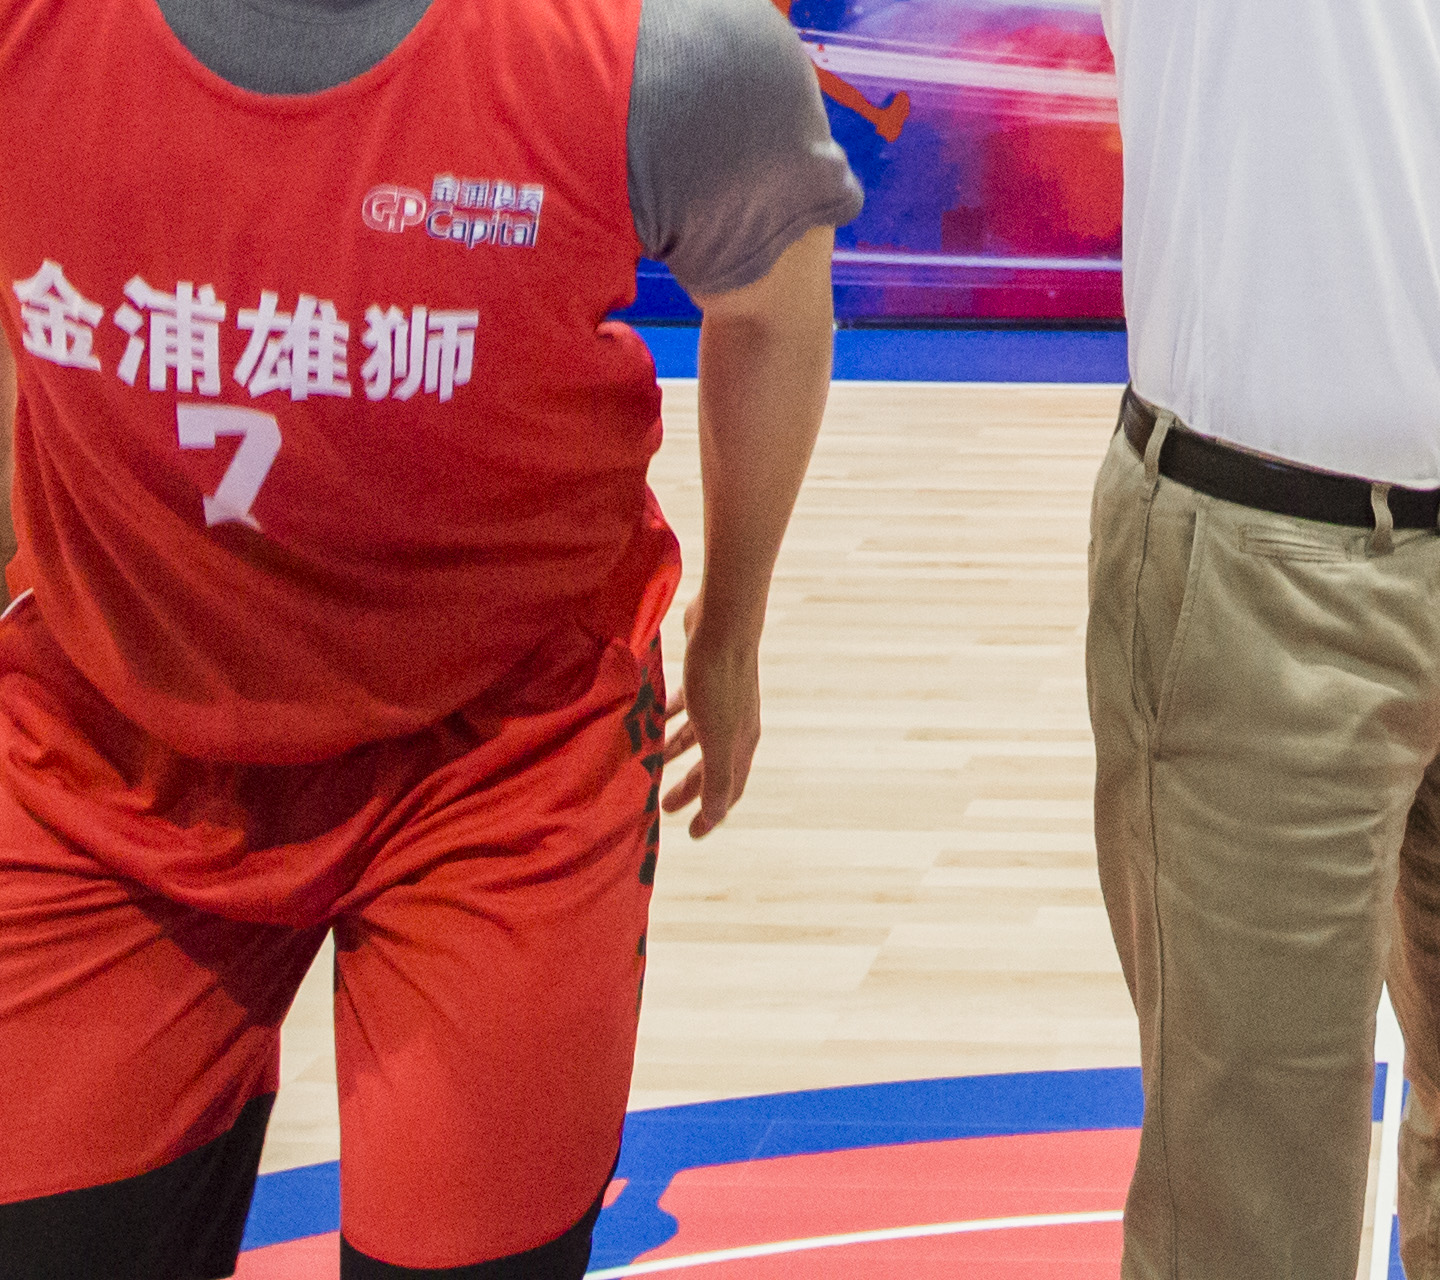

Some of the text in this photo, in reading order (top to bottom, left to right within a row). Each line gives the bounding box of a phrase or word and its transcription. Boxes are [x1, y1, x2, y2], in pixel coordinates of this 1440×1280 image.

[425, 207, 539, 249] Capital
[13, 258, 479, 403] 金浦雄狮
[175, 402, 283, 534] 7
